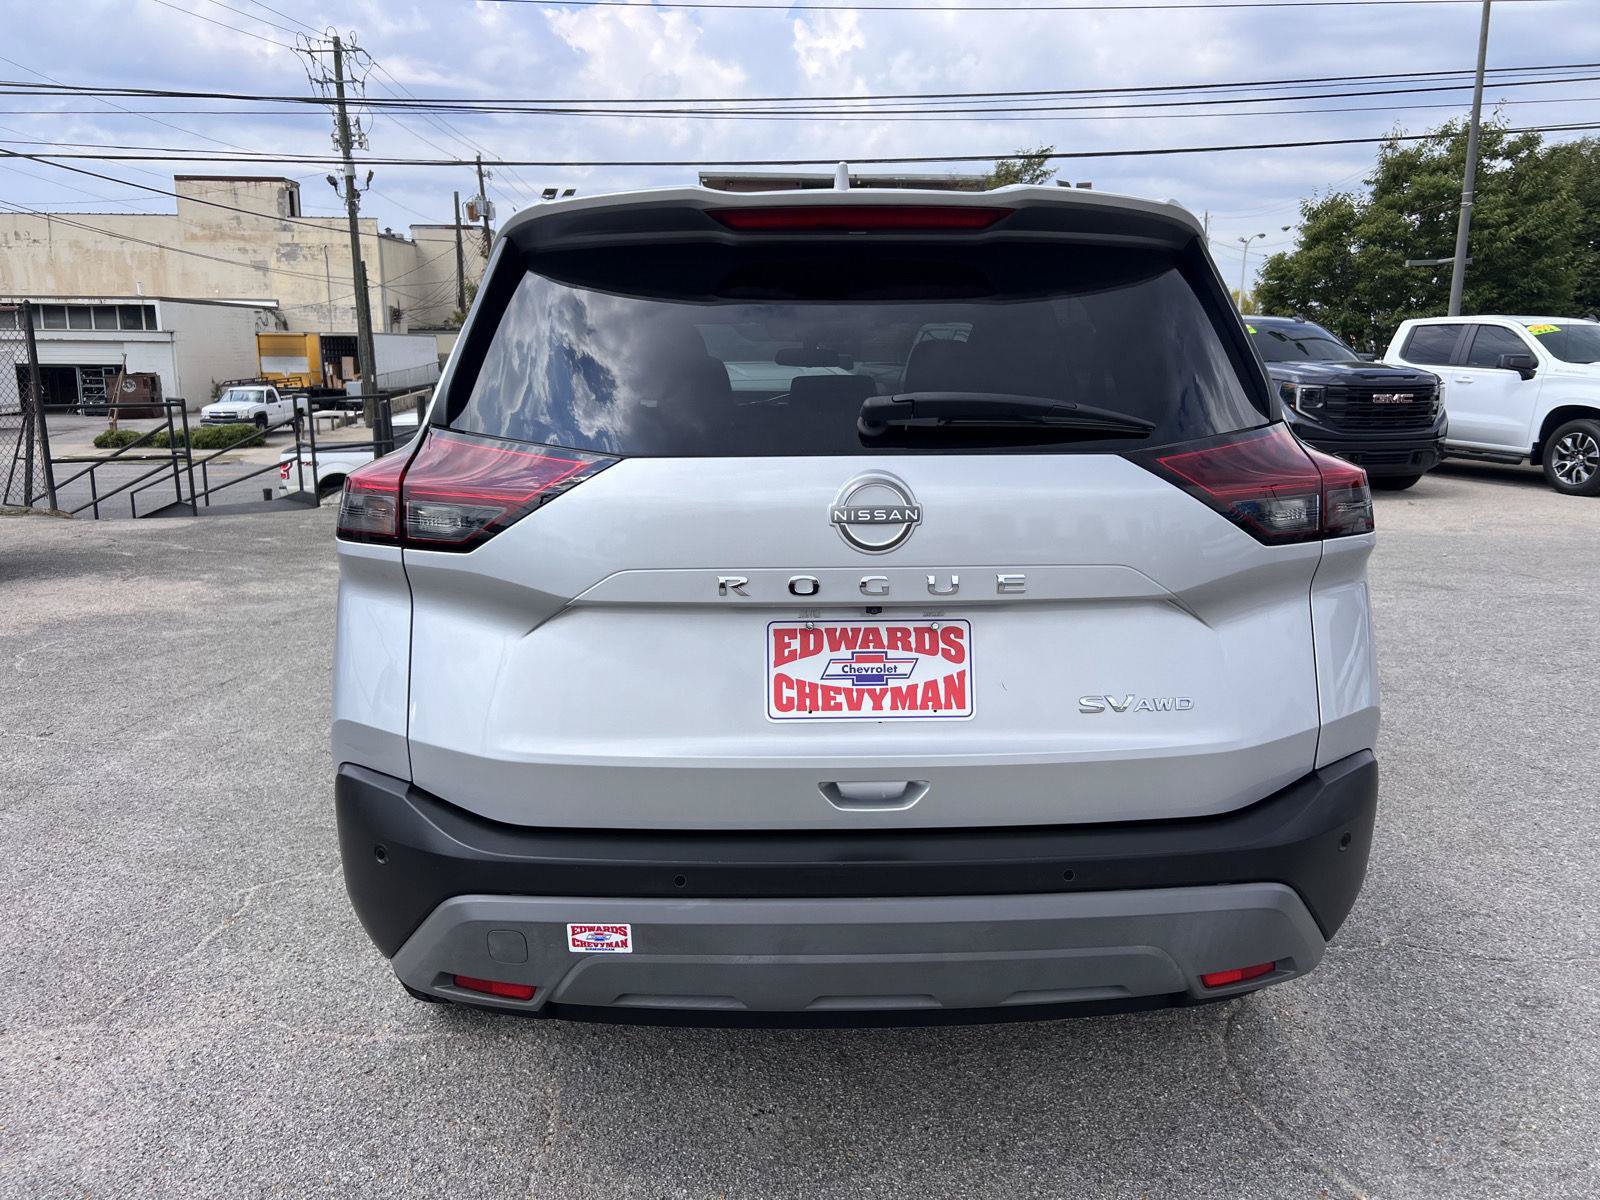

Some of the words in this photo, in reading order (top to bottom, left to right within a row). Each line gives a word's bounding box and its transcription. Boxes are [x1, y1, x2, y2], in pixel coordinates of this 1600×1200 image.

[1372, 393, 1414, 403] GMC
[834, 509, 918, 521] NISSAN
[717, 575, 1027, 596] ROGUE
[773, 625, 966, 668] EDWARDS
[841, 664, 898, 675] Chevrolet
[773, 669, 966, 712] CHEVYMAN
[1079, 694, 1135, 713] SV
[1133, 697, 1194, 712] AWD
[570, 925, 628, 936] EDWARDS
[571, 938, 629, 948] CHEVYMAN
